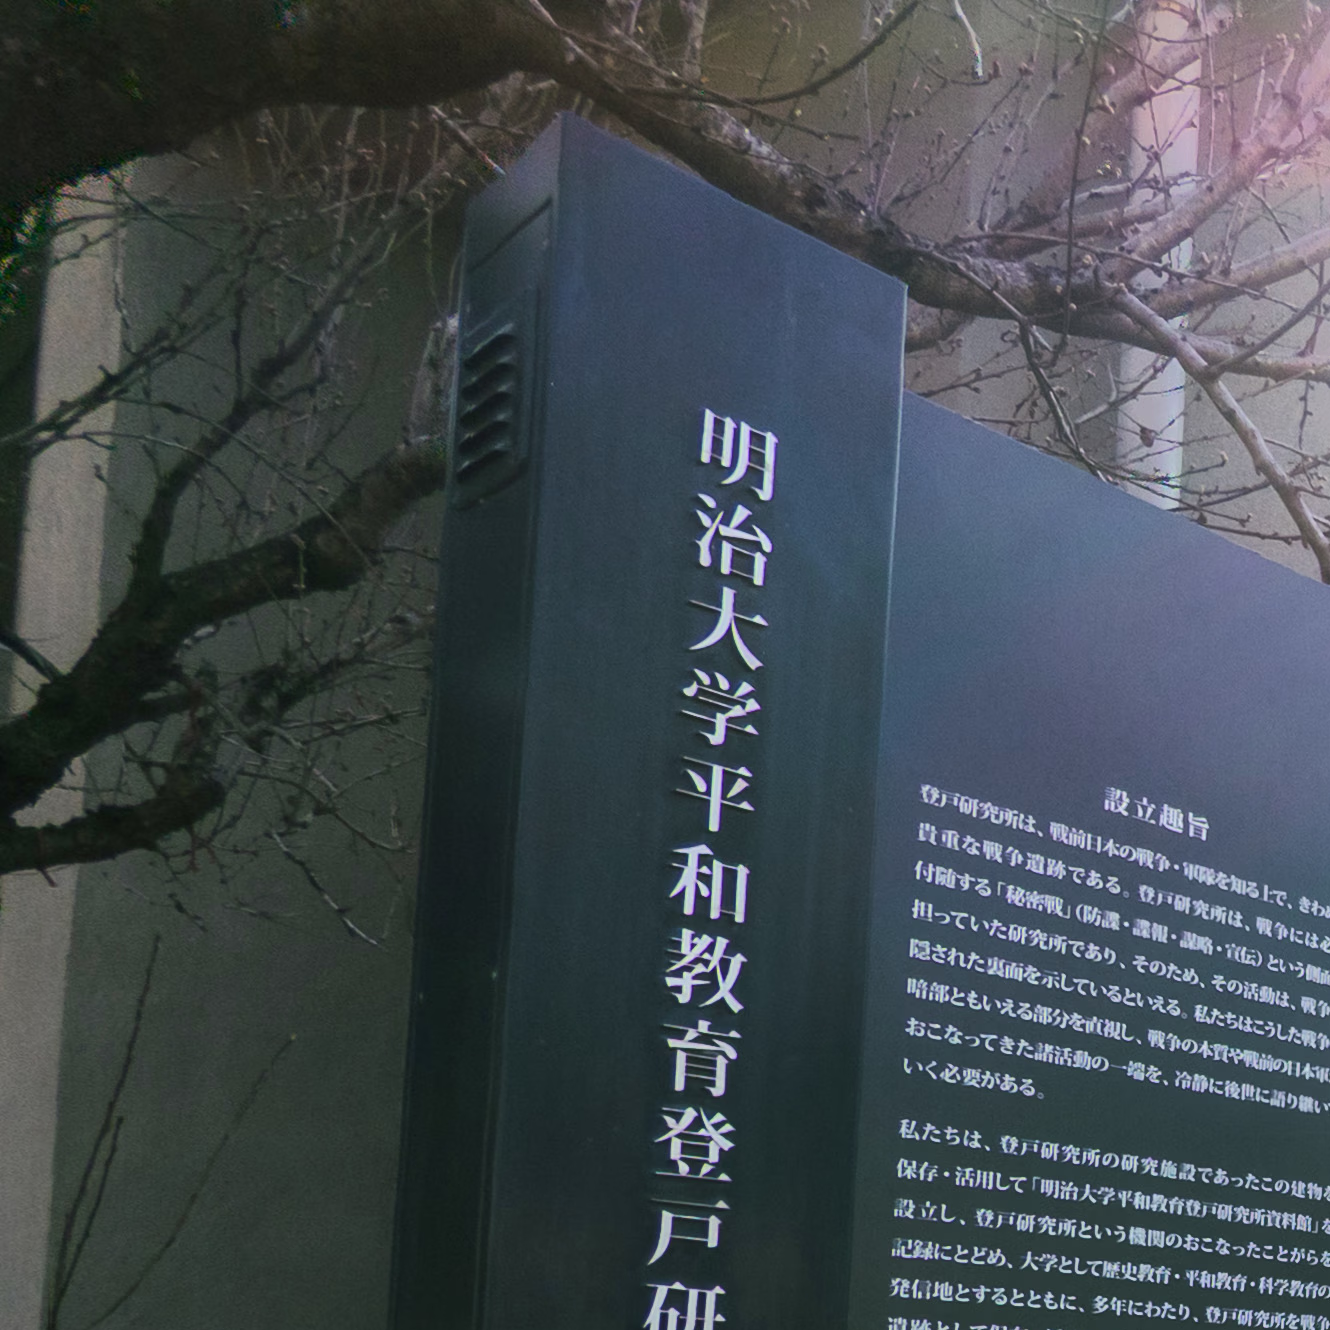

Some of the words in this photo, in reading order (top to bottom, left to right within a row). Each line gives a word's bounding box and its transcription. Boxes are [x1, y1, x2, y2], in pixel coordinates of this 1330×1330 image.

[1104, 786, 1209, 842] 設立趣旨
[903, 1057, 1044, 1099] いく必要がある。
